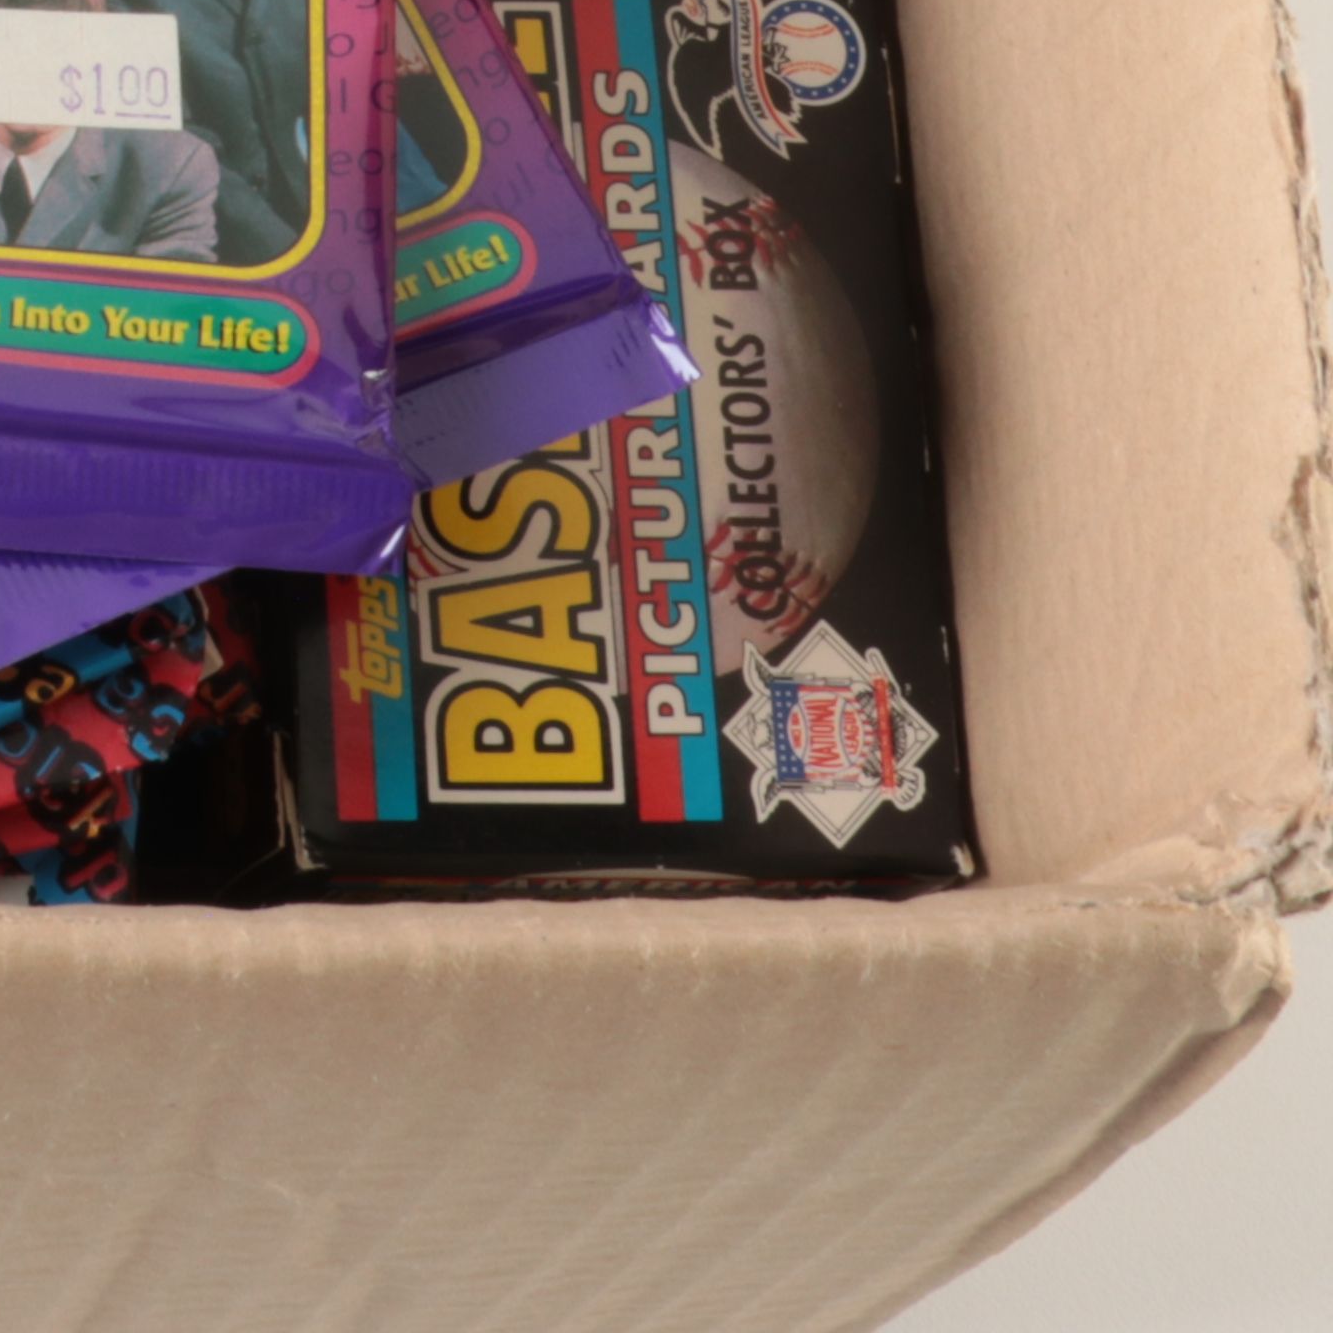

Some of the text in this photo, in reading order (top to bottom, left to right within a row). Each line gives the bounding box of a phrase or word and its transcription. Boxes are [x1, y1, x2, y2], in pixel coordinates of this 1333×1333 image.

[738, 0, 769, 120] AMERICAN LEAGUE
[592, 69, 671, 303] ARDS
[424, 233, 511, 290] Life!
[702, 196, 759, 292] BOX
[10, 295, 91, 336] Into
[103, 303, 189, 347] Your
[197, 314, 291, 357] Life!
[804, 697, 845, 770] NATIONAL
